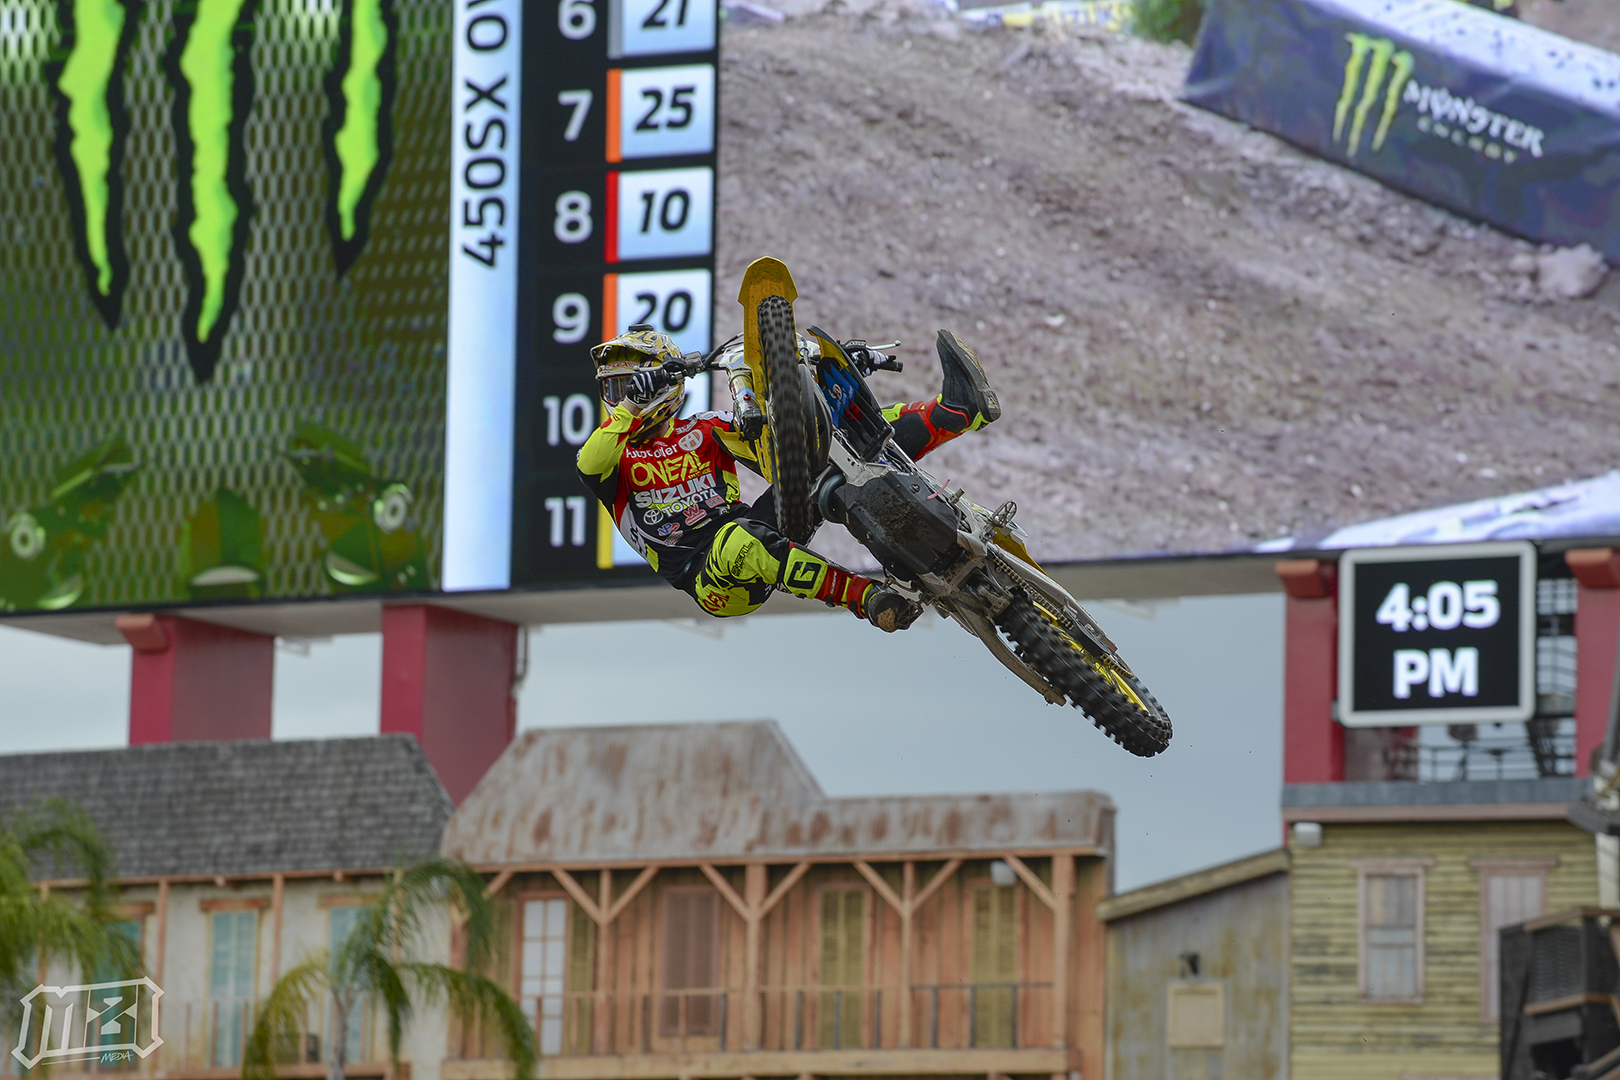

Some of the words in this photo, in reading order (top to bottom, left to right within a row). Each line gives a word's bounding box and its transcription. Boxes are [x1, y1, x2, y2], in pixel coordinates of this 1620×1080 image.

[557, 0, 597, 41] 6
[557, 89, 593, 142] 7
[634, 86, 696, 132] 25
[1403, 79, 1544, 158] MONSTER
[462, 75, 508, 268] 450SX
[553, 190, 594, 244] 8
[640, 188, 691, 235] 10
[551, 291, 591, 344] 9
[634, 290, 693, 332] 20
[542, 393, 595, 447] 10
[626, 443, 678, 459] Autotader
[634, 473, 717, 509] SUZUKI
[661, 488, 719, 518] TOYOTA
[544, 495, 587, 548] 11
[1375, 579, 1501, 633] 4:05
[1392, 646, 1480, 699] PM
